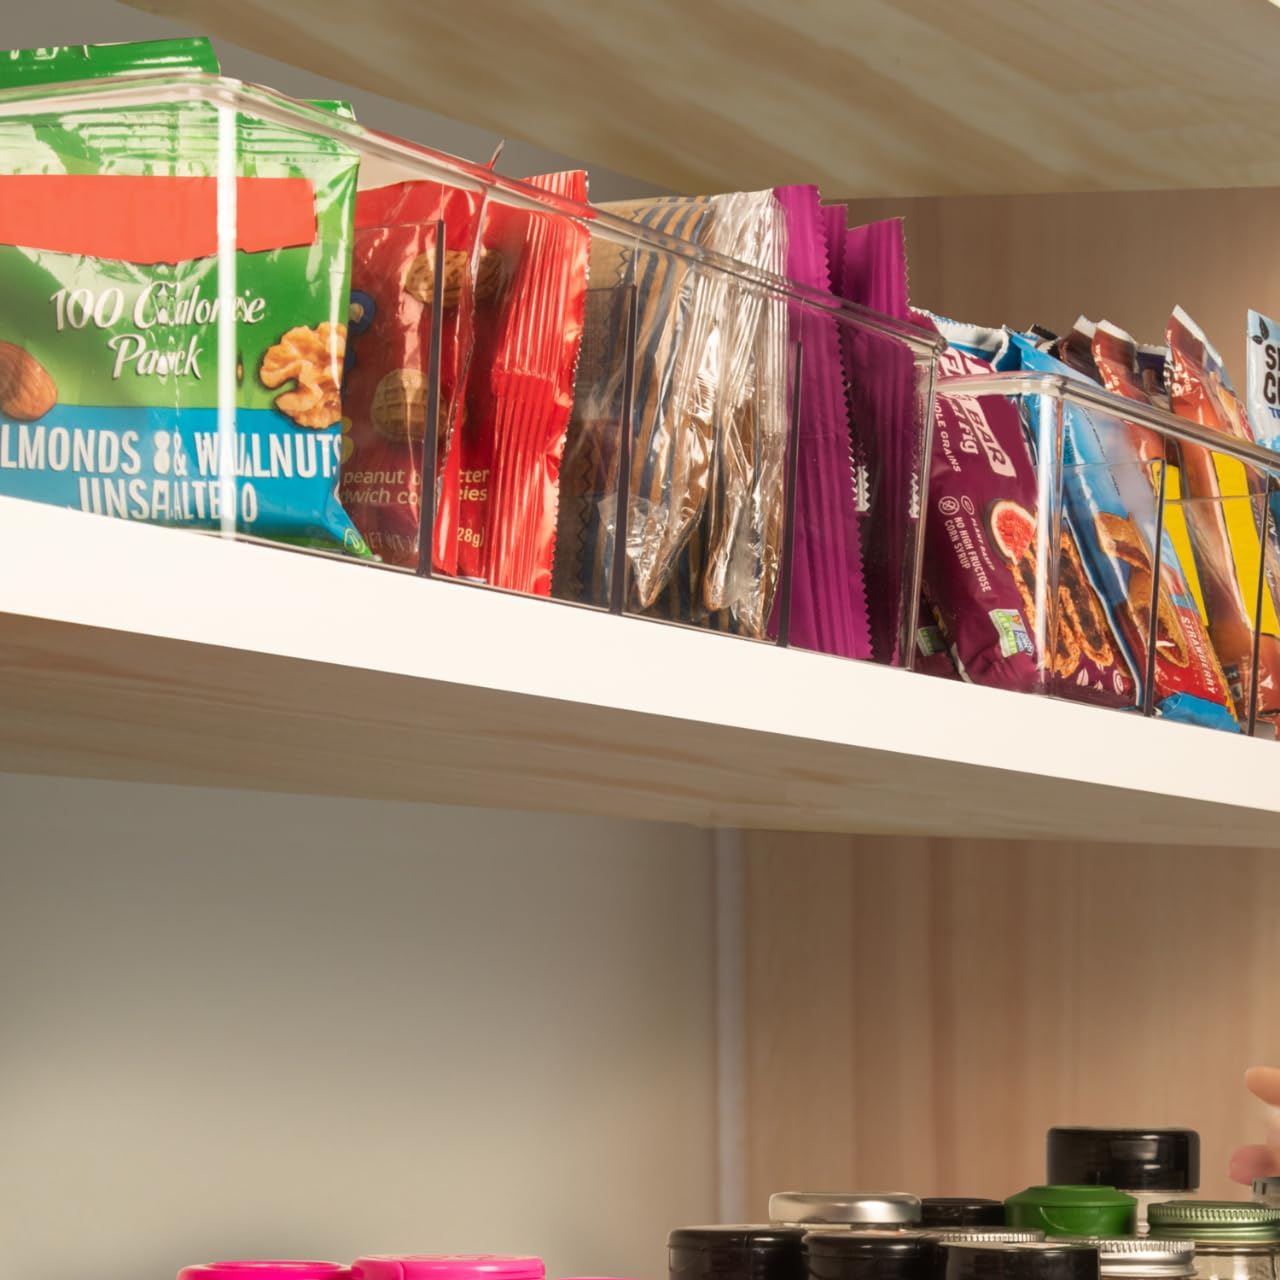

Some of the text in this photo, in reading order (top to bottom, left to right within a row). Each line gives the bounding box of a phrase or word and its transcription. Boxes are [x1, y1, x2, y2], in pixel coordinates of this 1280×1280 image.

[51, 286, 124, 332] 100
[107, 332, 204, 379] Pack
[940, 430, 962, 473] GRAINS
[957, 421, 979, 455] Fig
[966, 407, 1007, 466] BAR
[343, 469, 405, 487] peanut
[944, 518, 971, 571] CORN SYRUP
[953, 516, 992, 593] NO HIGH FRUCTOSE
[1181, 615, 1218, 695] STRAWBERRY
